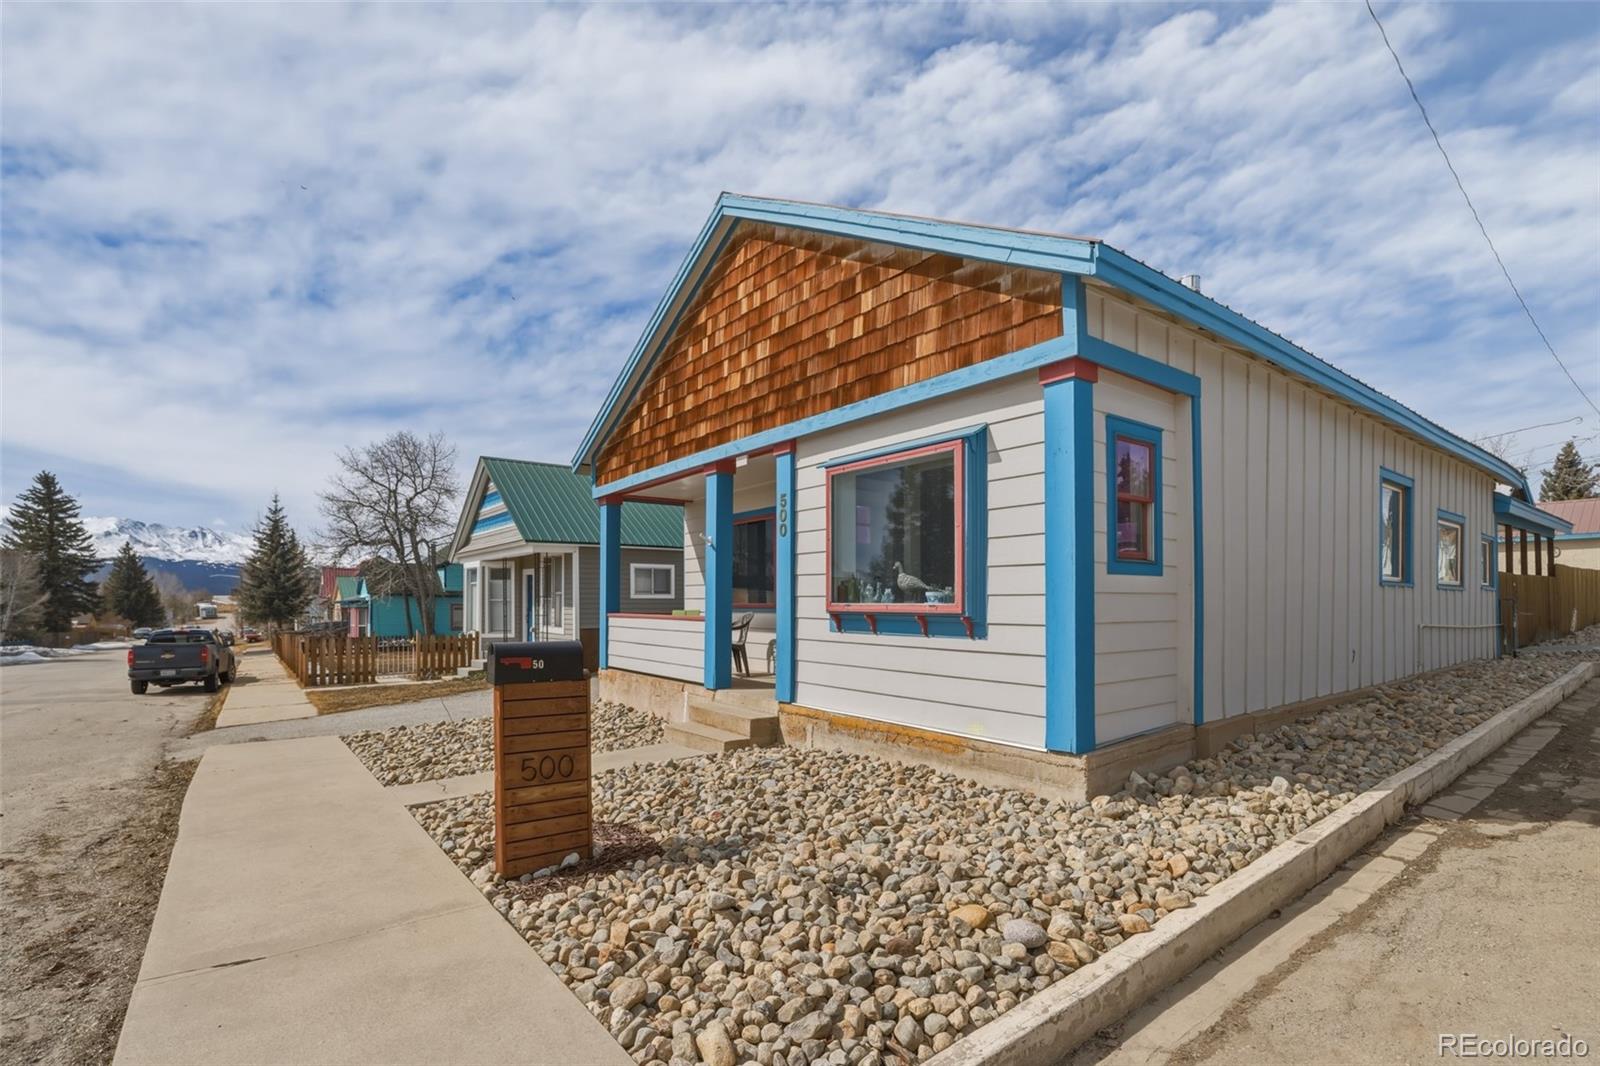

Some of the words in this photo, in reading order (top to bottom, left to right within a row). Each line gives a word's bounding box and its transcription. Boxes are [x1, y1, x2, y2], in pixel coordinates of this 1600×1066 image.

[780, 493, 788, 538] 500
[532, 659, 545, 669] 50
[521, 754, 575, 782] 500
